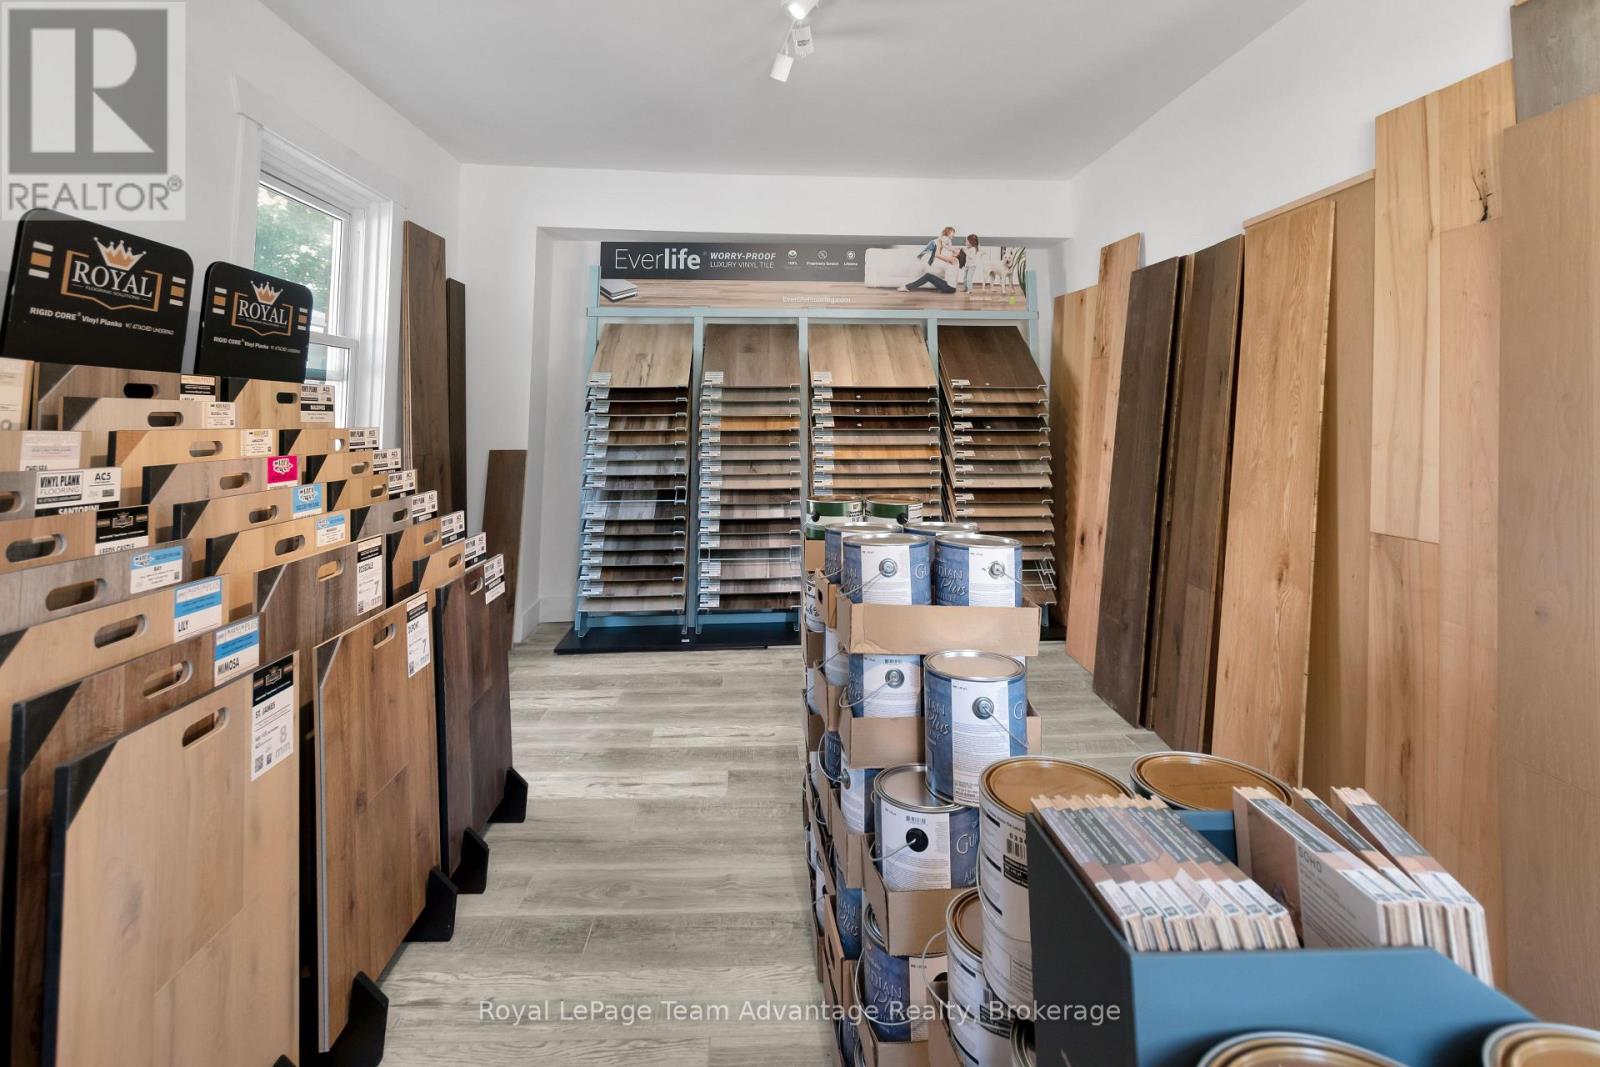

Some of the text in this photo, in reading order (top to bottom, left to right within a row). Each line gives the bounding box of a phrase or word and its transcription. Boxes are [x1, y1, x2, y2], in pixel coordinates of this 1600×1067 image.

[615, 247, 701, 270] Everlife
[710, 252, 777, 261] WORRY-PROOF
[71, 259, 154, 298] ROYAL
[29, 306, 54, 318] RIGID
[82, 315, 100, 325] Vinyl
[100, 318, 123, 328] Planks
[237, 299, 288, 326] ROYAL
[40, 474, 80, 488] VINYL PLANK
[94, 472, 112, 481] AC5
[40, 486, 80, 496] FLOORING
[217, 657, 240, 674] MIMOSA
[279, 723, 288, 743] 8
